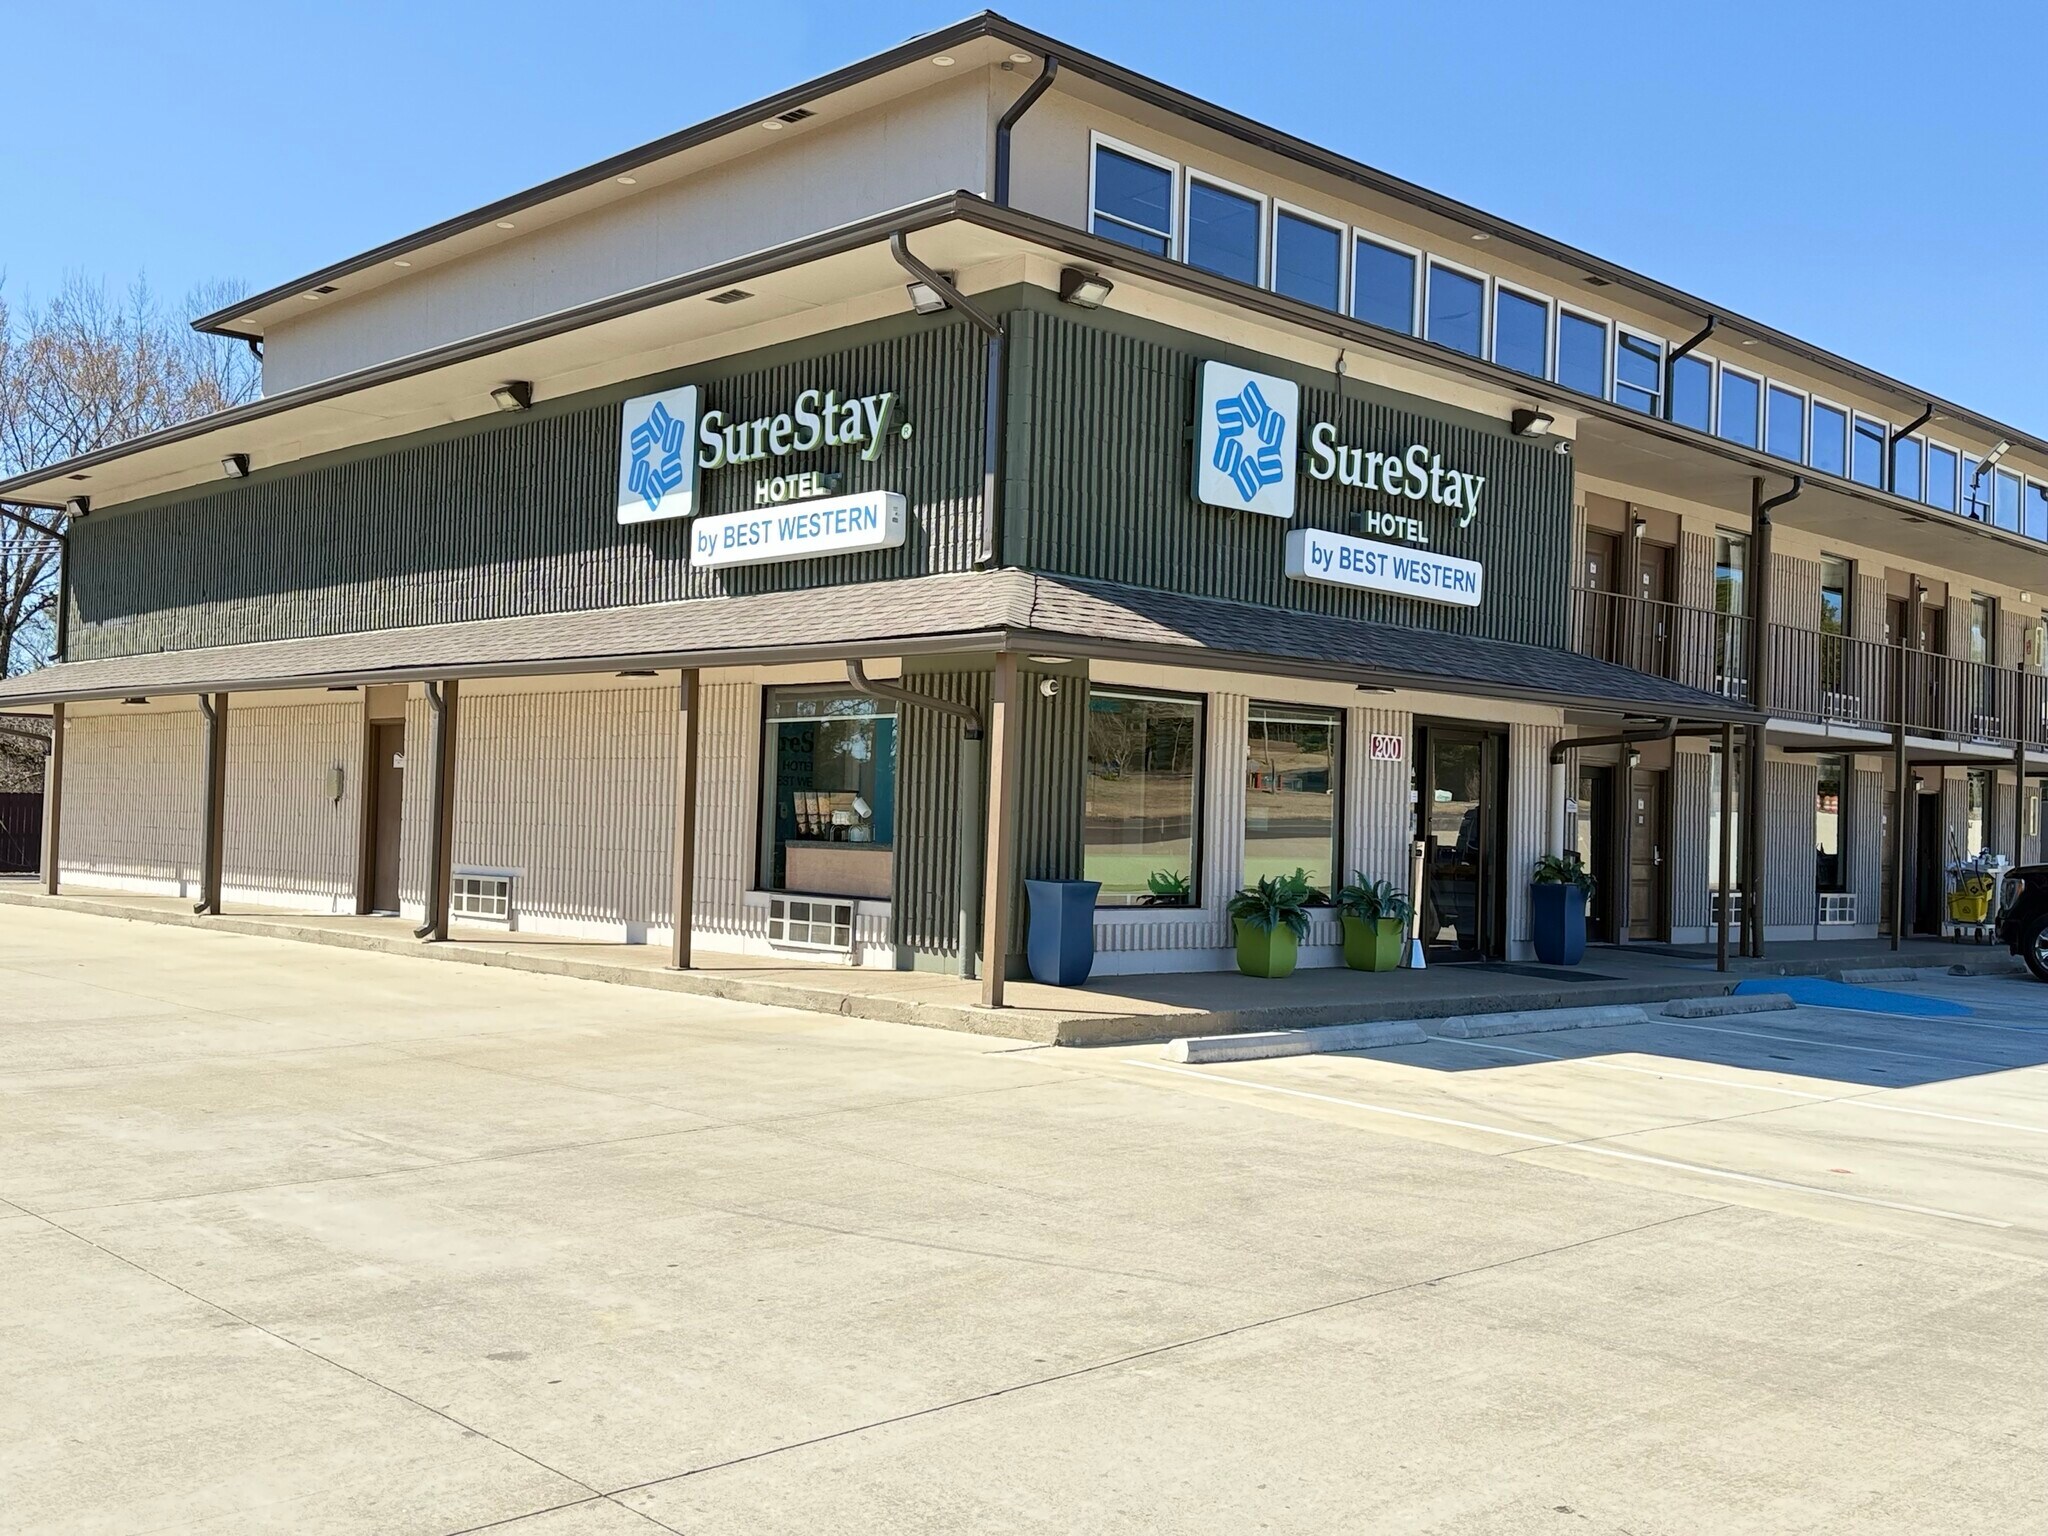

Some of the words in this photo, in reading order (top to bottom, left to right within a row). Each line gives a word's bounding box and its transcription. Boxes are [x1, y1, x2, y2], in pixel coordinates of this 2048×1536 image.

[698, 389, 896, 469] SureStay
[755, 472, 828, 505] HOTEL
[1309, 421, 1486, 528] SureStay
[698, 530, 718, 556] by
[724, 520, 773, 549] BEST
[778, 504, 878, 541] WESTERN
[1366, 510, 1429, 543] HOTEL
[1312, 541, 1333, 572] by
[1339, 546, 1388, 576] BEST
[1393, 556, 1476, 593] WESTERN
[1375, 736, 1399, 759] 200
